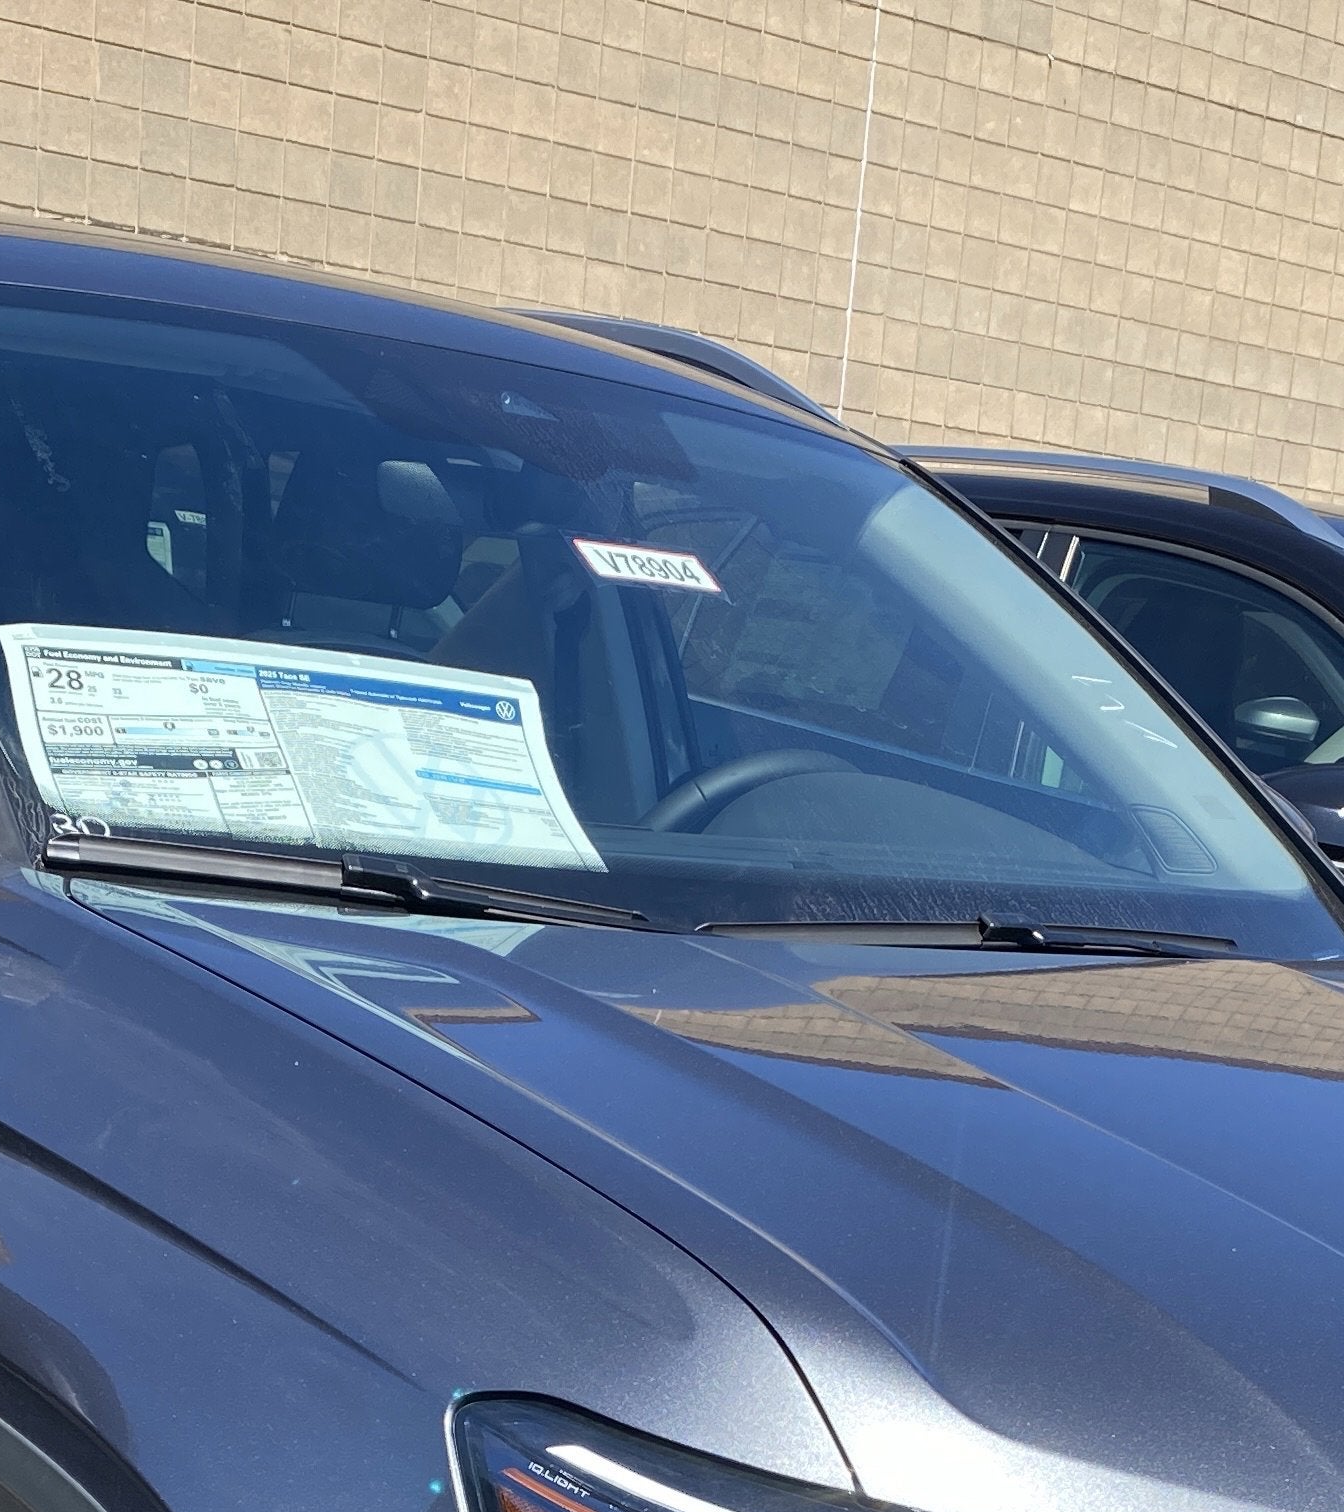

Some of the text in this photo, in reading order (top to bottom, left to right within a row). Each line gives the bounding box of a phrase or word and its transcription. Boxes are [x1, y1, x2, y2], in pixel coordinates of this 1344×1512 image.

[593, 548, 702, 584] V78904
[43, 649, 172, 668] Fuel Economy and Environment
[46, 667, 84, 691] 28
[84, 670, 105, 680] MPG
[258, 669, 277, 679] 2025
[189, 682, 209, 695] $0
[77, 716, 103, 725] cost
[47, 724, 104, 737] $1,900
[49, 755, 138, 768] fueleconomy.gov
[527, 1461, 591, 1498] IQ.LIGHT
